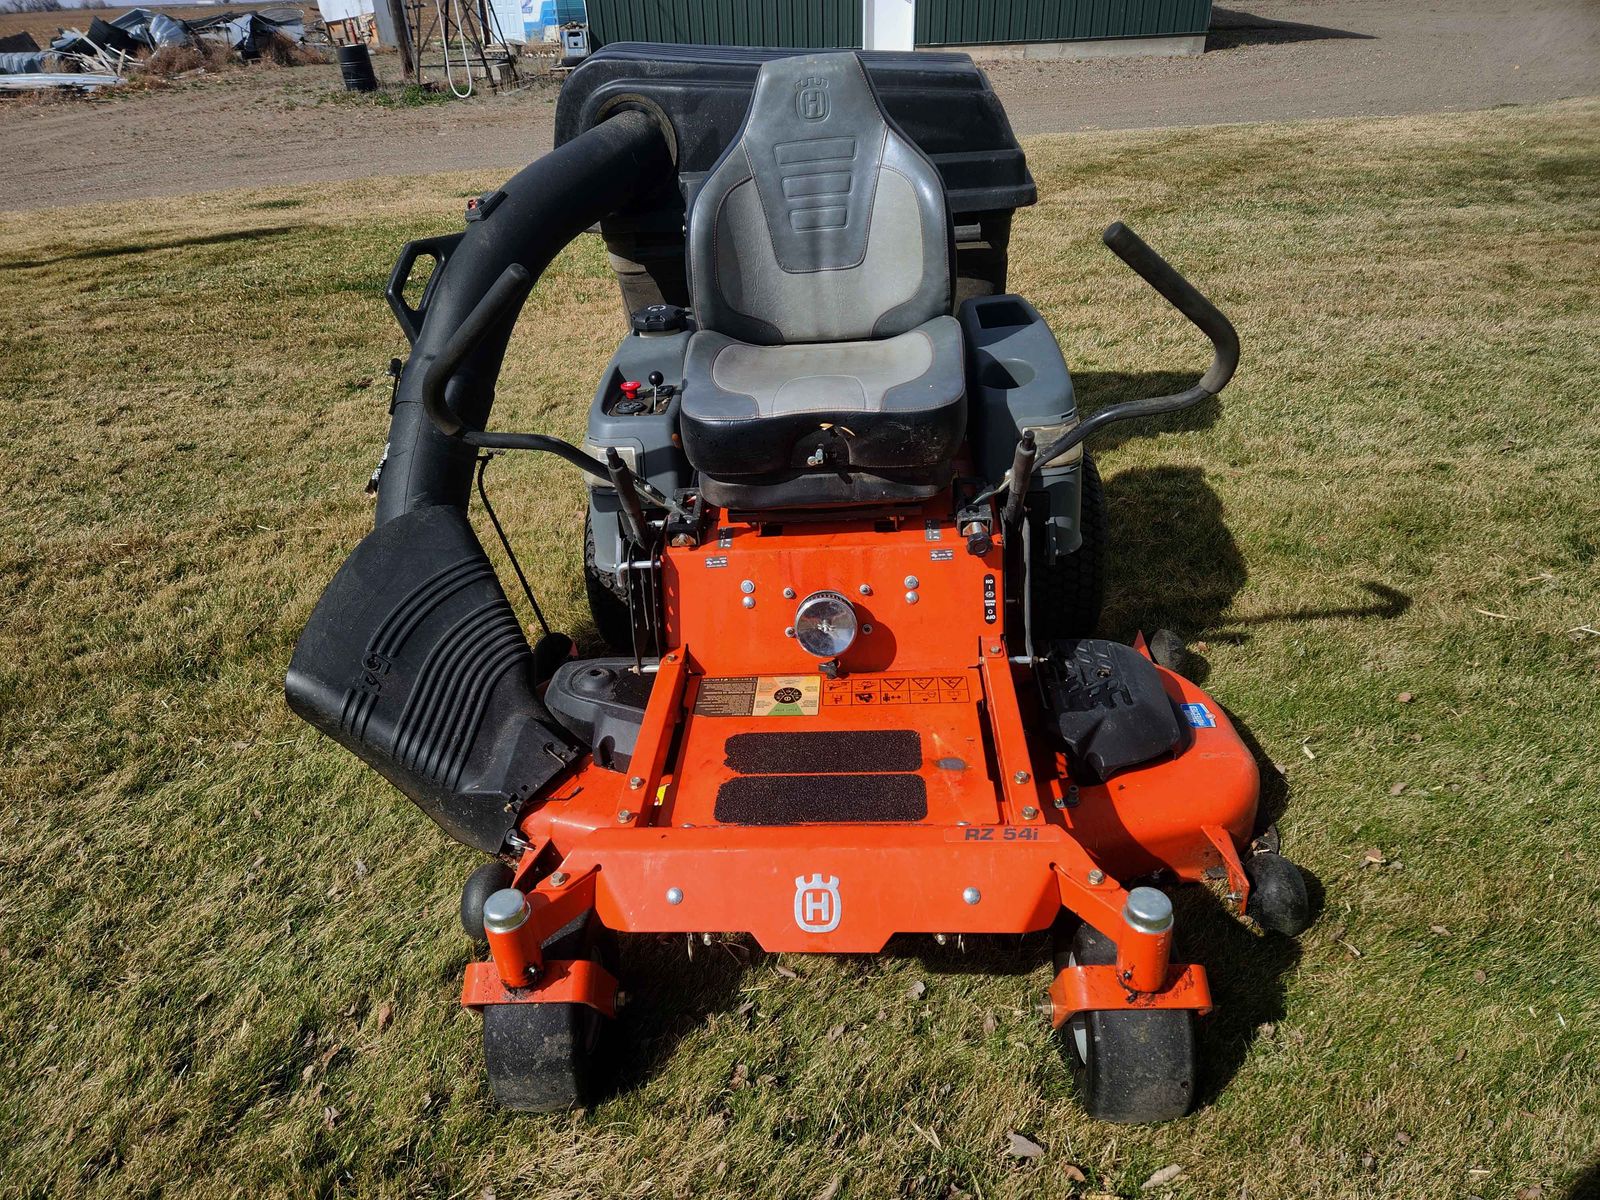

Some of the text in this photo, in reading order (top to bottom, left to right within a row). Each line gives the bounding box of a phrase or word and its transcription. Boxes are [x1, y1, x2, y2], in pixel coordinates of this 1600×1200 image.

[965, 827, 1039, 841] RZ 54i
[806, 892, 830, 921] H
